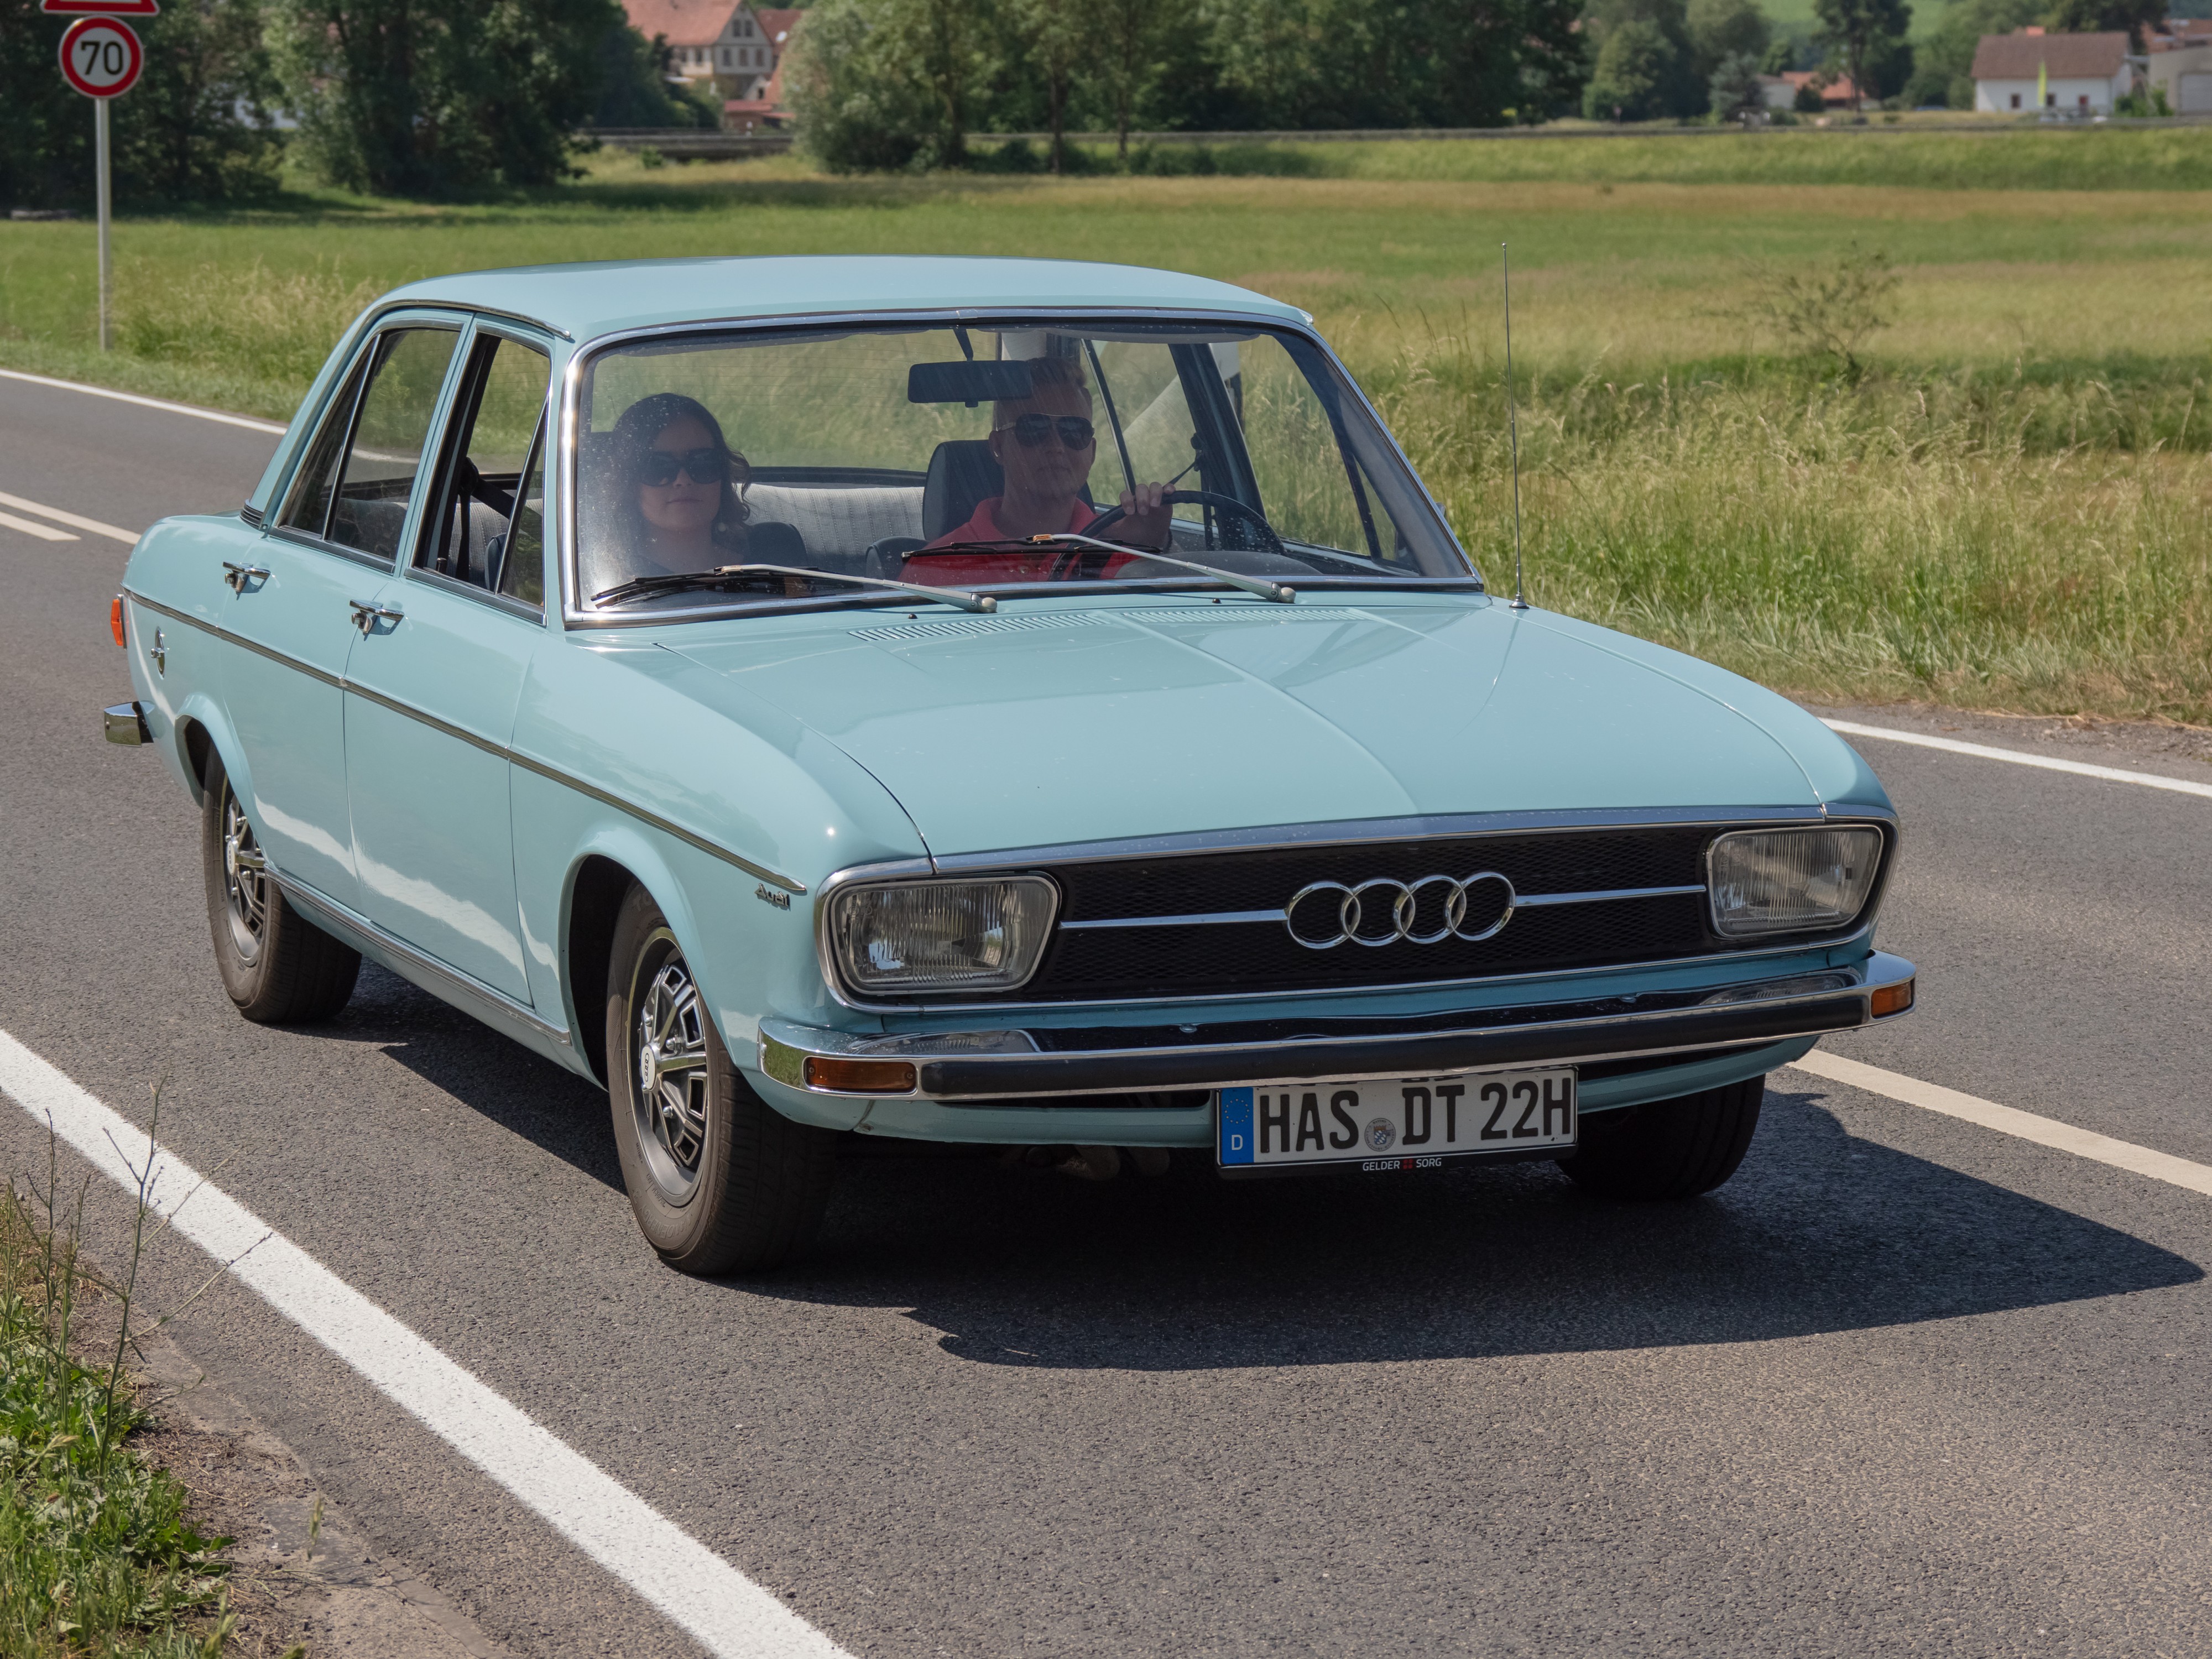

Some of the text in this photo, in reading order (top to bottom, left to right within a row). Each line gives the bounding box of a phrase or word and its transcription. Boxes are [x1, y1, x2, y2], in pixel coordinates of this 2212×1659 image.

[81, 41, 123, 75] 70
[754, 883, 790, 907] Audi
[1260, 1091, 1359, 1153] HAS
[1402, 1084, 1465, 1145] DT
[1480, 1078, 1571, 1140] 22H
[1232, 1135, 1243, 1150] D
[1363, 1158, 1442, 1171] GELDER SORG
